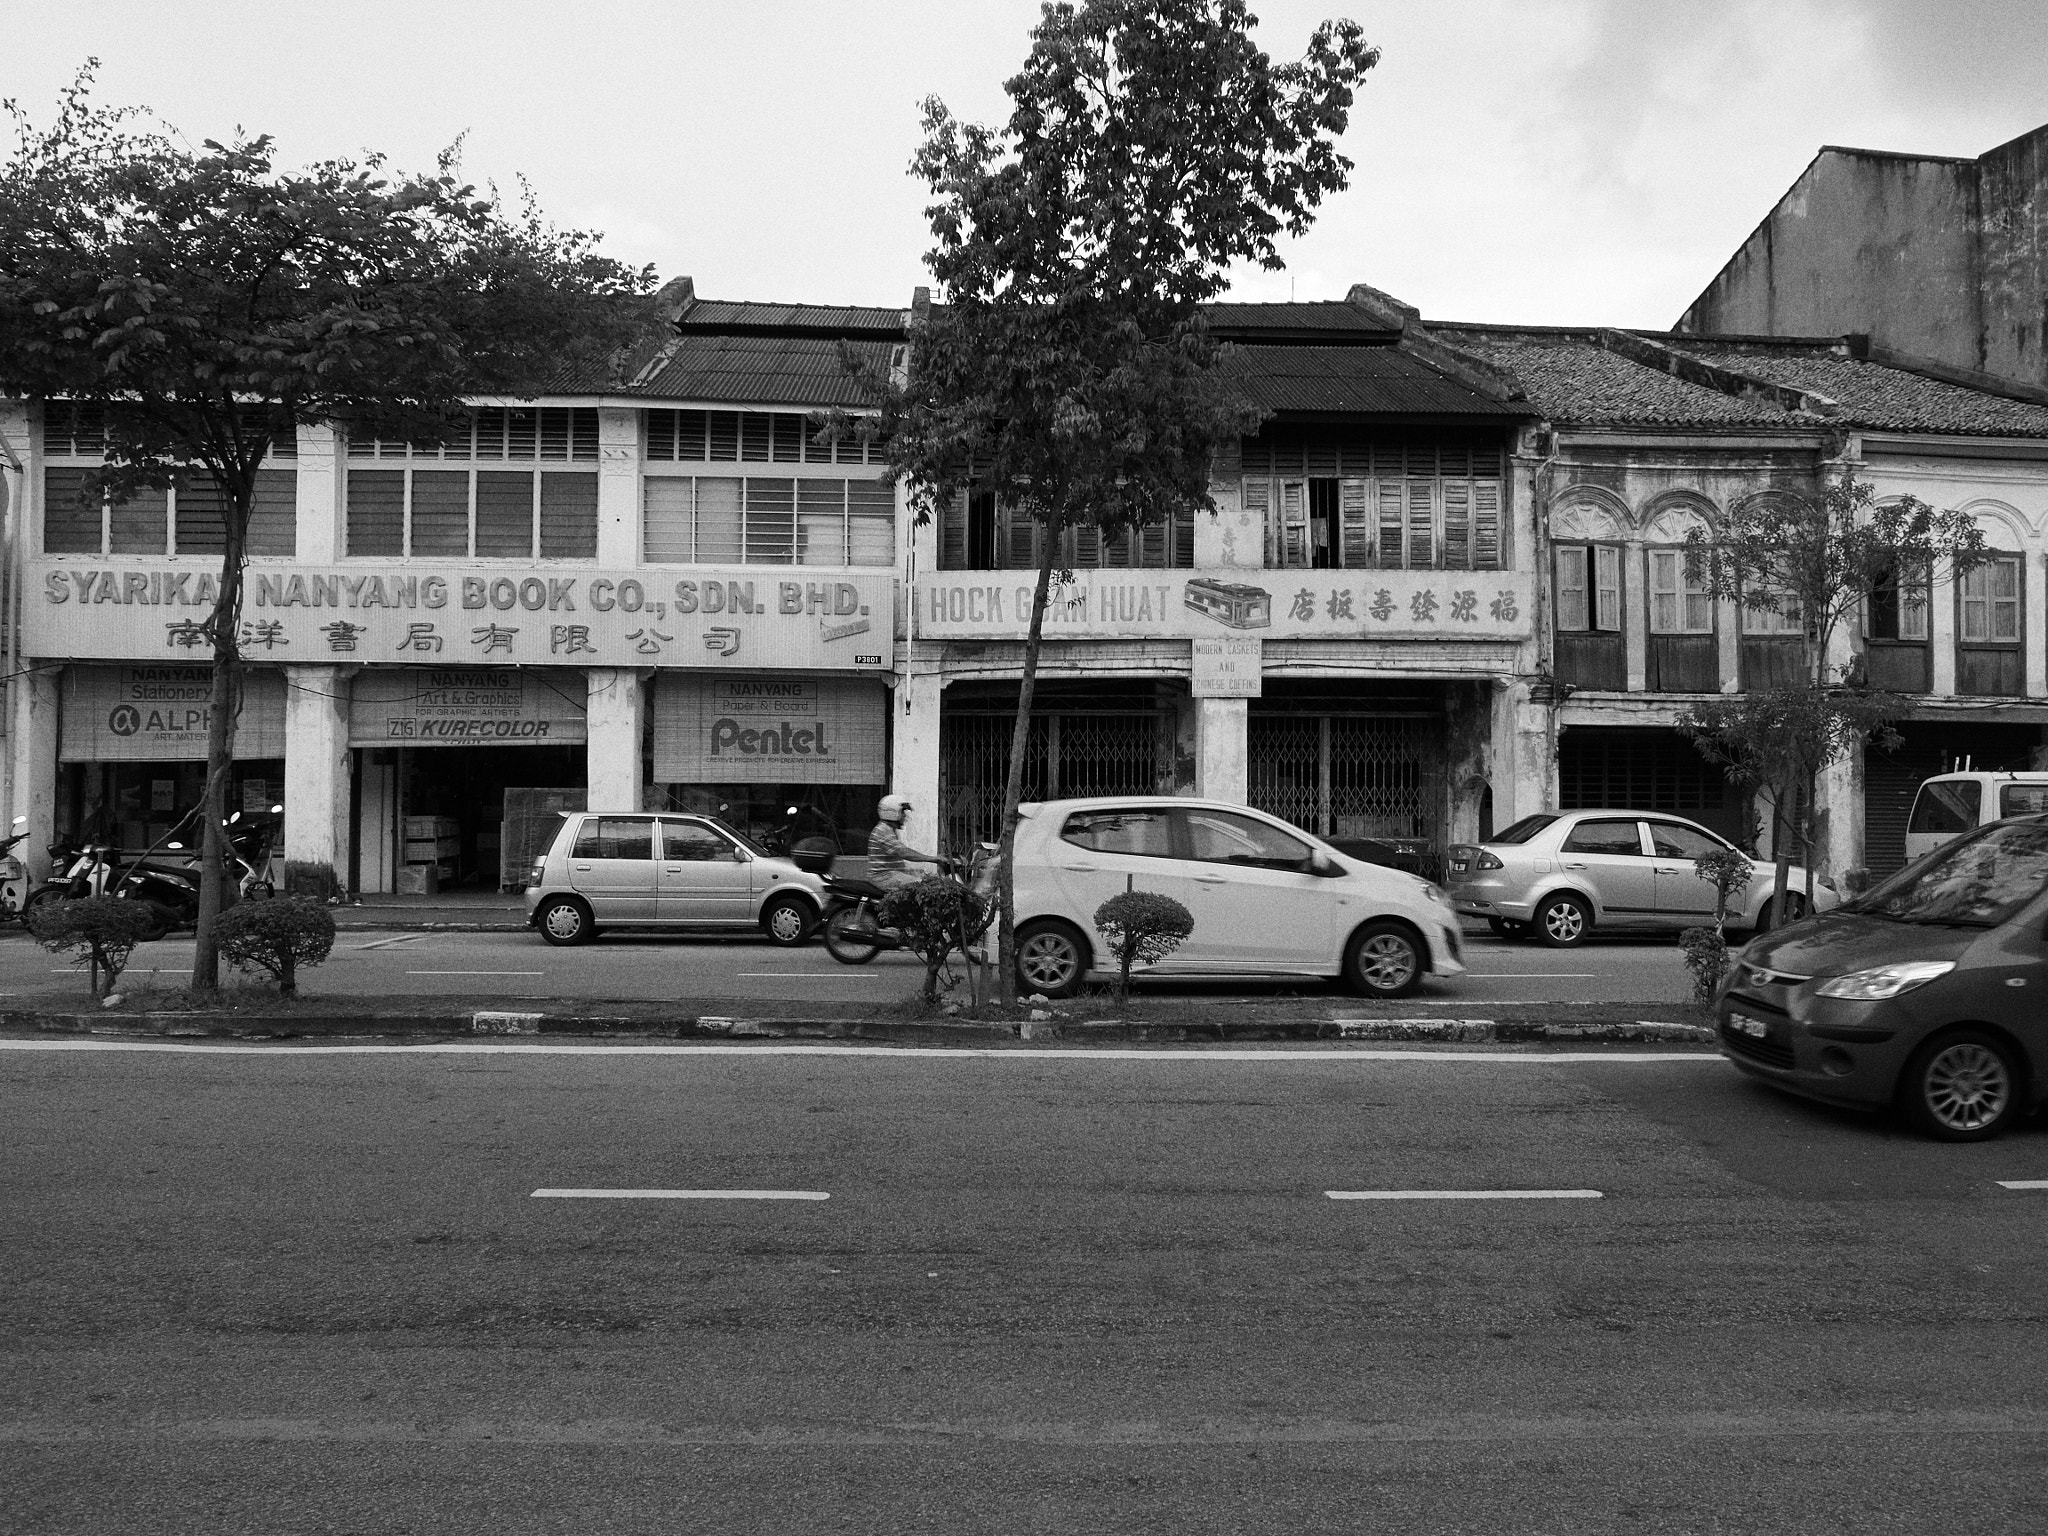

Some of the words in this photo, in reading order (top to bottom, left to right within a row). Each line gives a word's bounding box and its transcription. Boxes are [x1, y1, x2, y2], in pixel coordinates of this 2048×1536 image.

[256, 573, 448, 608] NANYANG
[462, 577, 576, 611] BOOK
[589, 579, 666, 620] CO.,
[675, 580, 765, 614] SDN.
[779, 582, 869, 616] BHD.
[931, 586, 1003, 623] HOCK
[1100, 585, 1171, 622] HUAT
[1195, 644, 1223, 655] MODERN
[1228, 644, 1259, 655] CASKETS
[132, 667, 213, 681] NANYAN
[1219, 661, 1235, 673] AND
[430, 673, 510, 687] NANYANG
[1196, 678, 1225, 690] CHINESE
[1229, 678, 1258, 690] COFFINS
[132, 684, 213, 700] Stationery
[730, 683, 802, 696] NANYANG
[422, 691, 446, 705] Art
[452, 691, 462, 705] &
[465, 691, 520, 708] Graphics
[722, 699, 755, 712] Paper
[760, 700, 769, 710] &
[774, 700, 809, 711] Board
[415, 708, 432, 716] FOR
[436, 708, 476, 716] GRAPHIC
[481, 708, 521, 717] ARTISTS
[389, 720, 414, 736] ZIG
[420, 719, 550, 737] KURECOLOR
[154, 732, 173, 741] ART
[711, 718, 829, 755] Pentel
